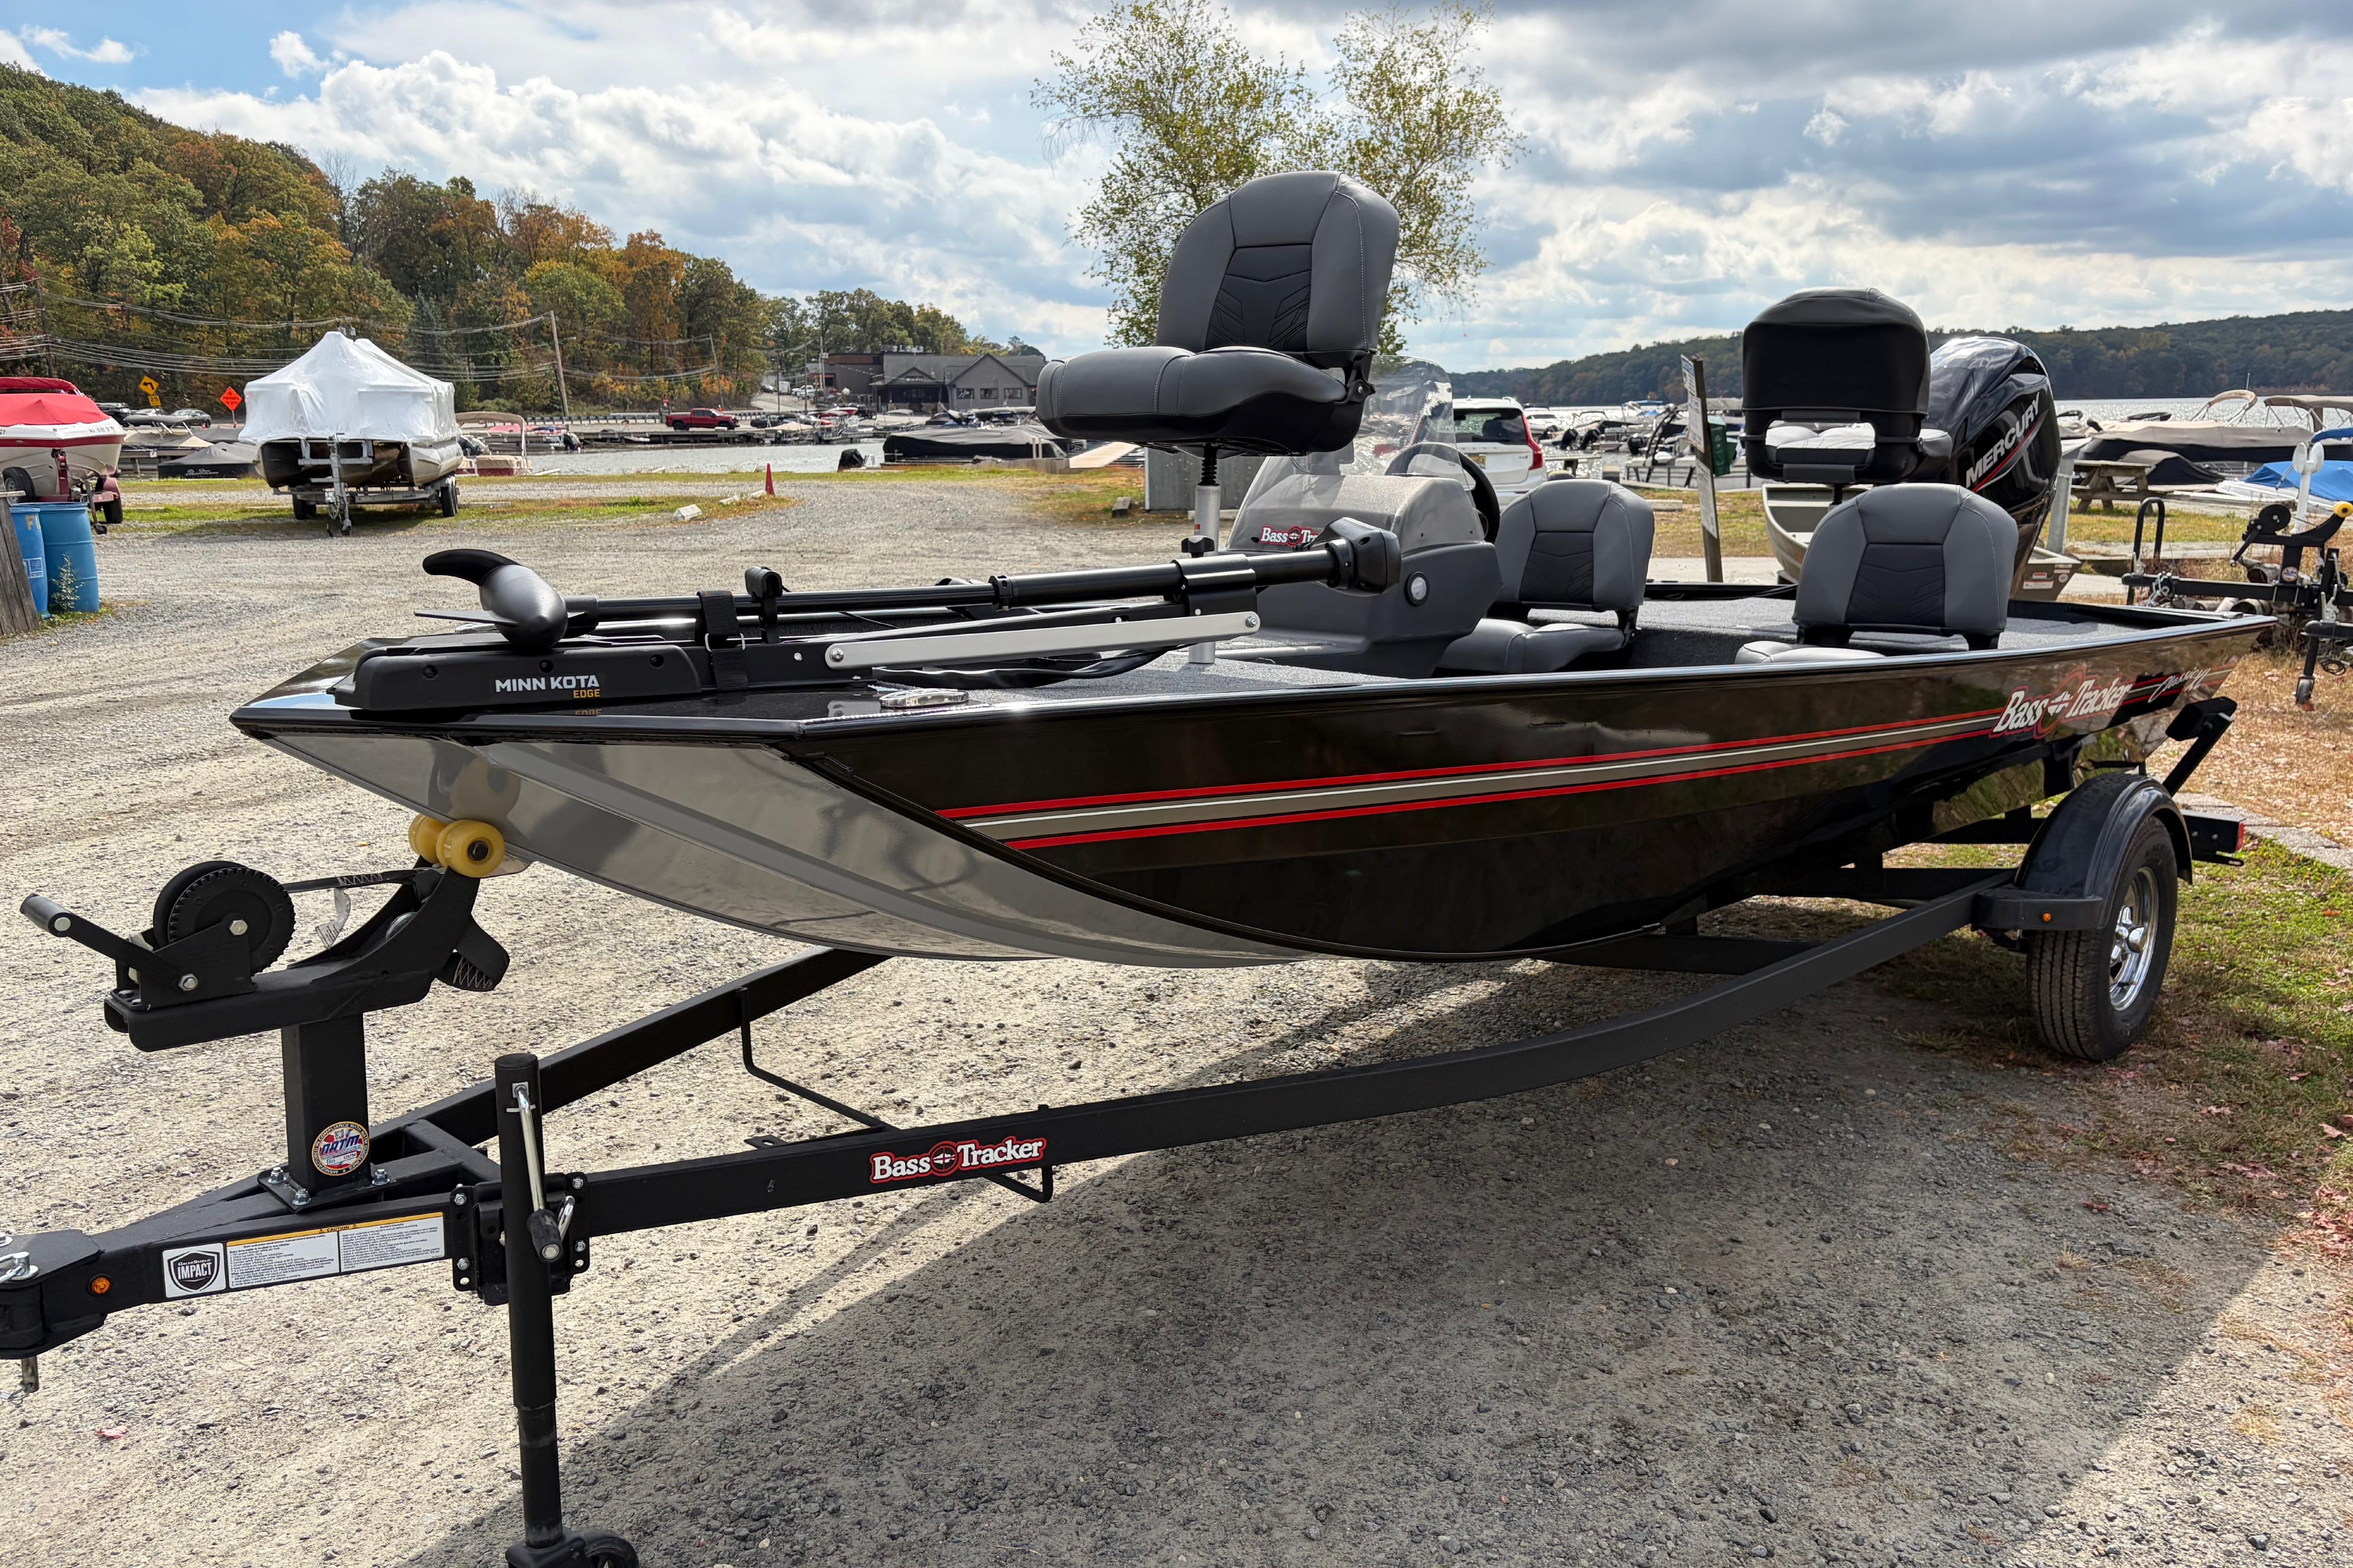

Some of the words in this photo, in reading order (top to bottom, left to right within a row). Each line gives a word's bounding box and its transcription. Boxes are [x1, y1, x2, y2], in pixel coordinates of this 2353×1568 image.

[1966, 391, 2040, 488] MERCURY
[1261, 527, 1289, 543] Bass
[495, 677, 546, 692] MINN
[550, 675, 600, 689] KOTA
[573, 689, 601, 698] EDGE
[1993, 690, 2049, 732] Bass
[2066, 677, 2133, 718] Tracker
[319, 1123, 349, 1141] COMPLIANCE
[350, 1123, 362, 1132] WITH
[873, 1156, 930, 1179] Bass
[957, 1139, 1043, 1167] Tracker
[177, 1262, 212, 1280] IMPACT
